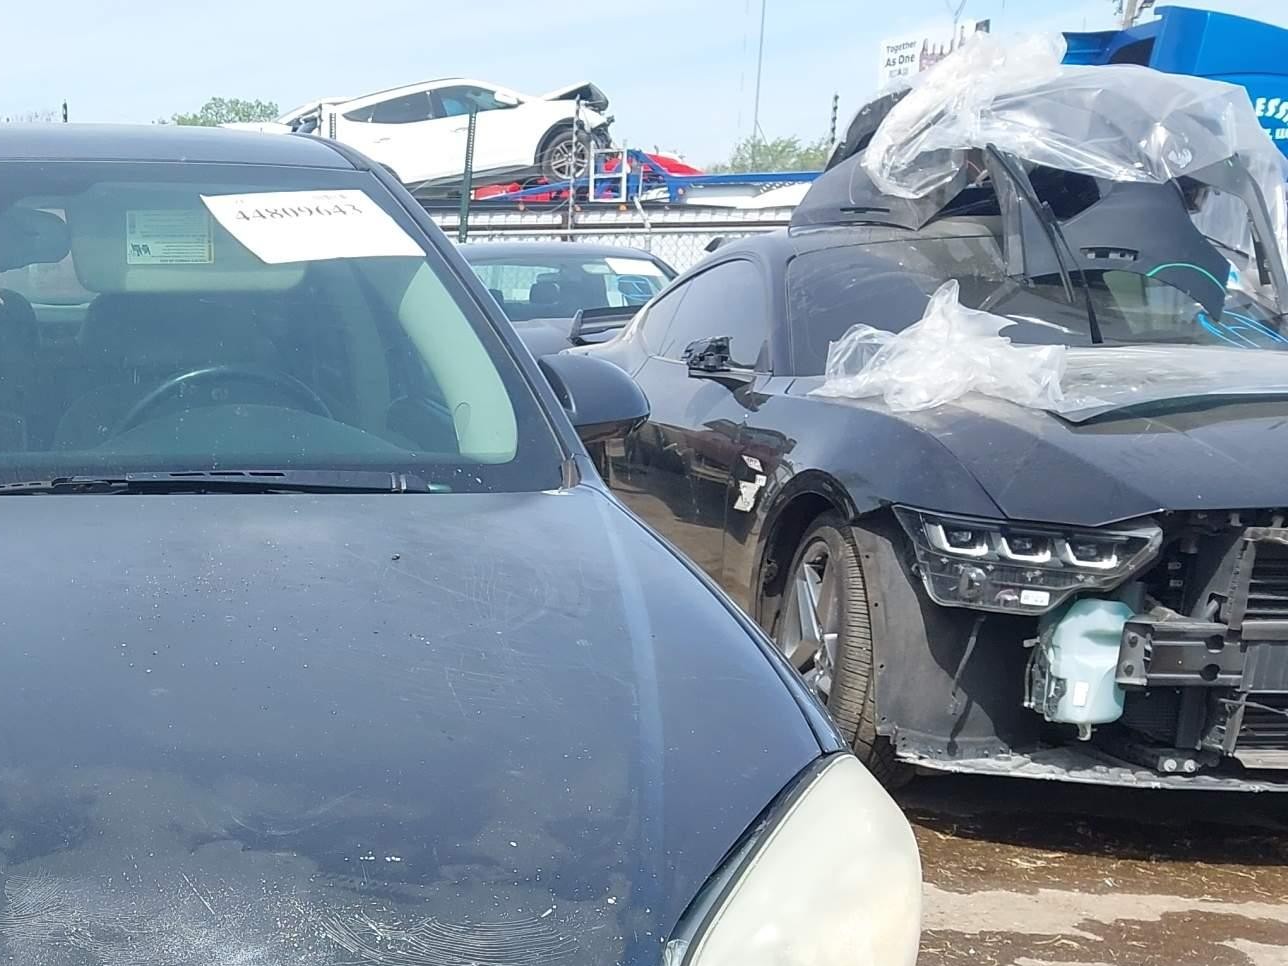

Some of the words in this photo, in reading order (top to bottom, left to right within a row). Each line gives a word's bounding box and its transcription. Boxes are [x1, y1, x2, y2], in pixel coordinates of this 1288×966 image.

[886, 40, 918, 54] Together
[885, 57, 897, 68] As
[899, 54, 915, 65] One
[236, 203, 363, 221] 44809643
